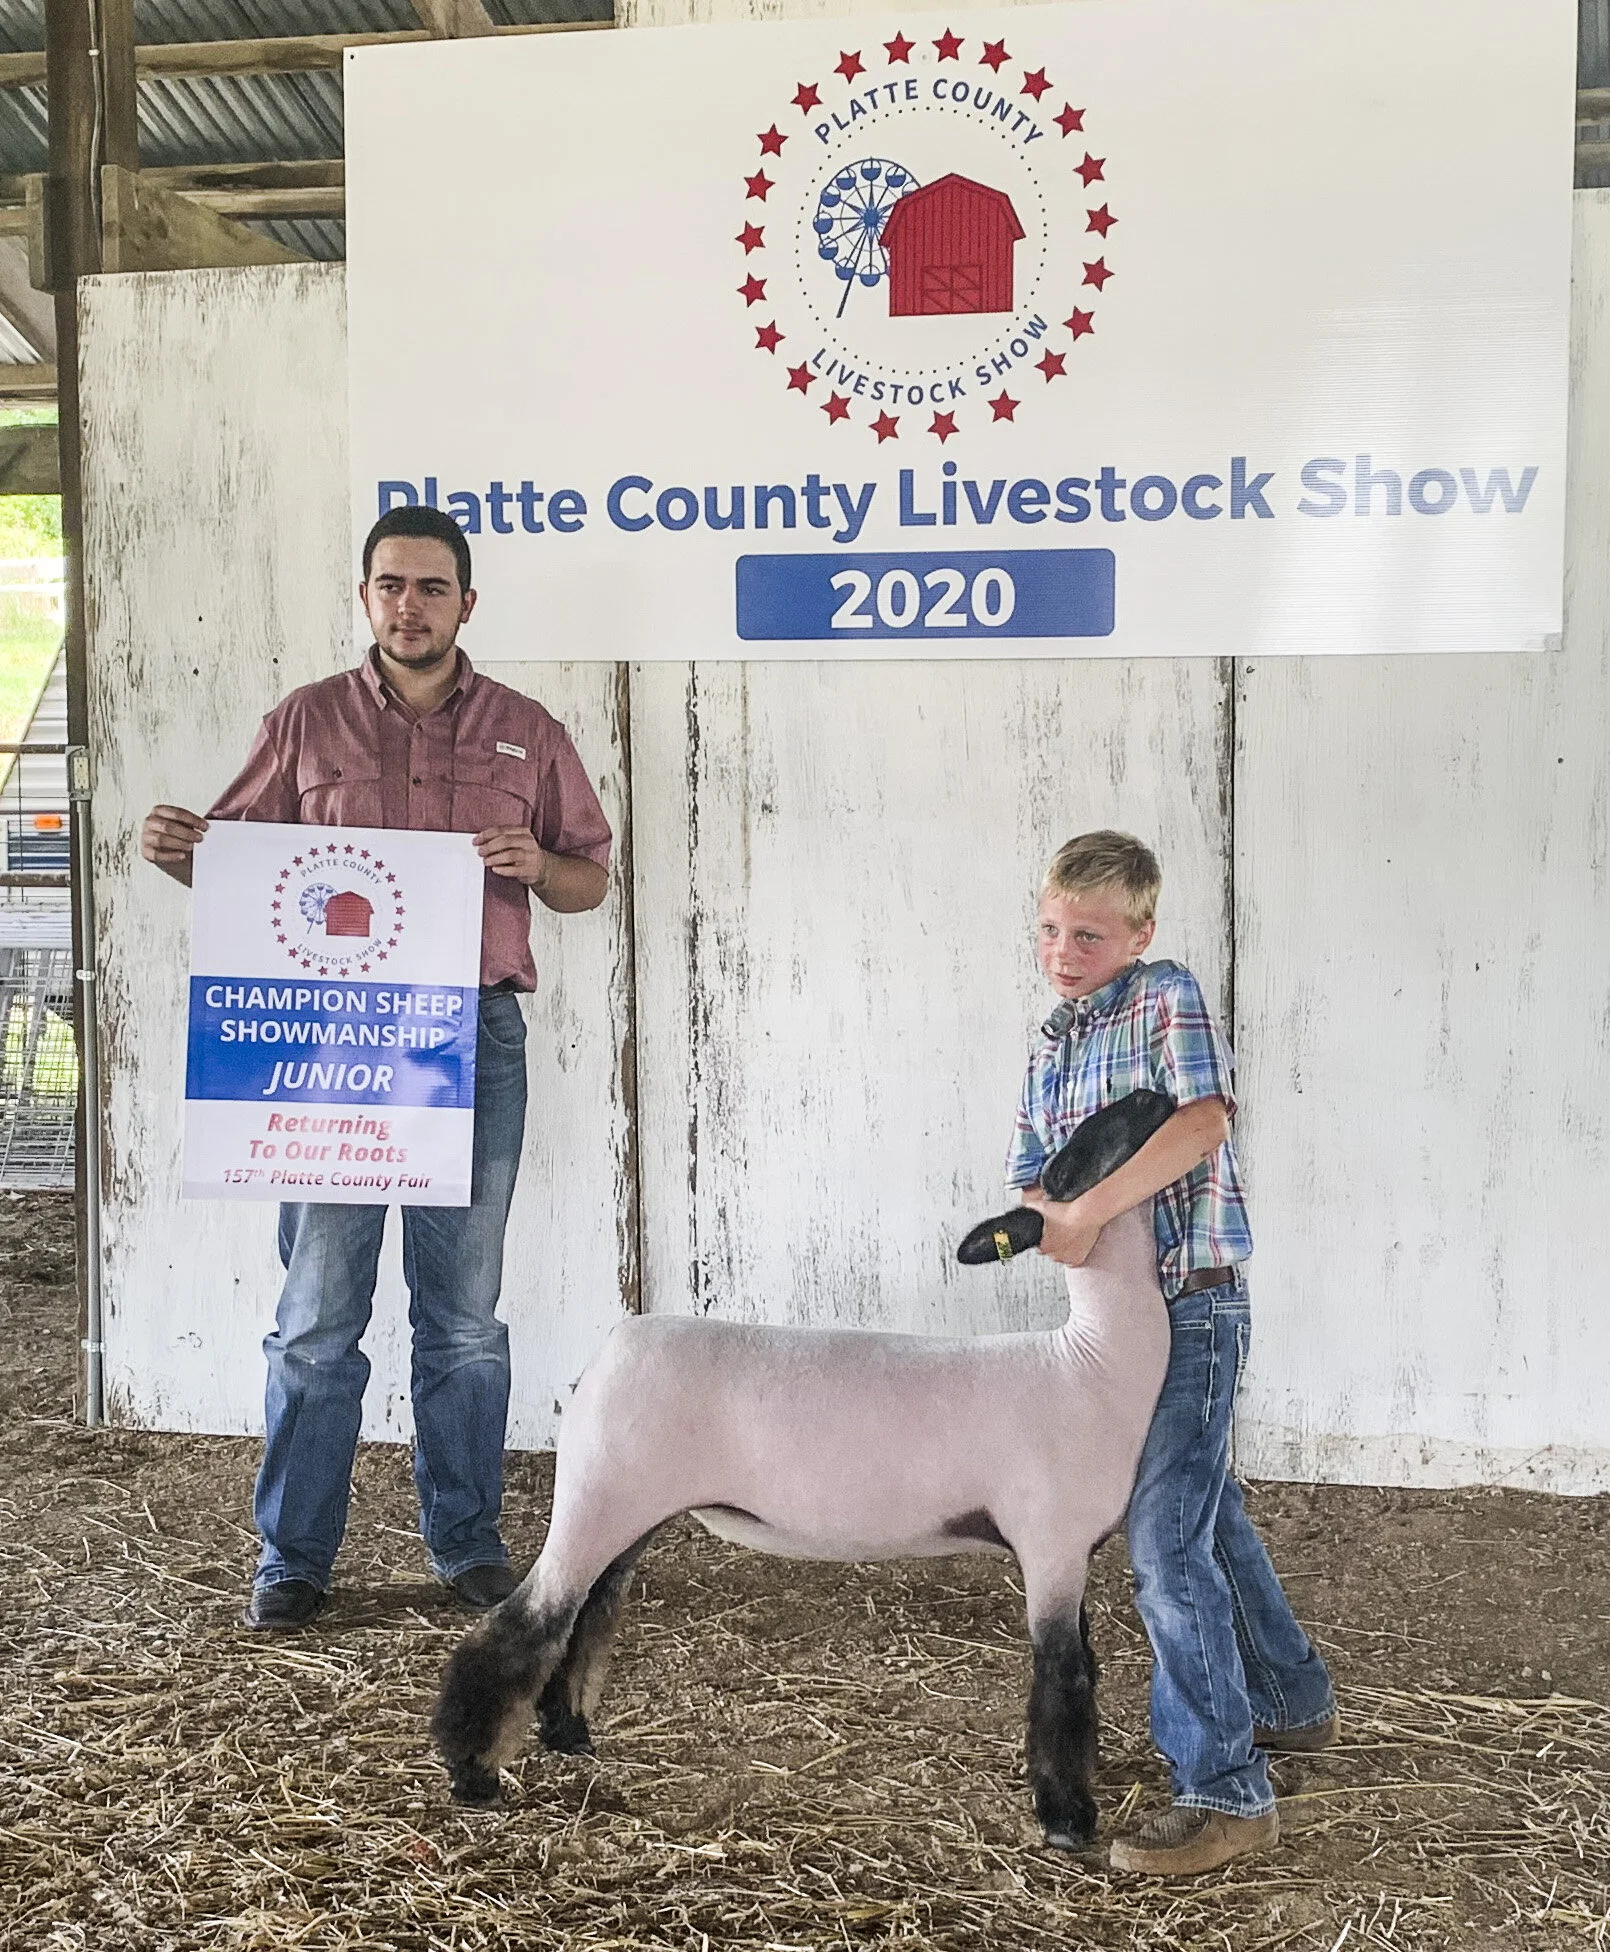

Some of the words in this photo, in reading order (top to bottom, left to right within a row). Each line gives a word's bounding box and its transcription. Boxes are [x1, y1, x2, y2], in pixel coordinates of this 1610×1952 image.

[813, 79, 920, 145] PLATTE
[932, 78, 1045, 146] COUNTY
[811, 347, 967, 406] LIVESTOCK
[975, 313, 1049, 386] SHOW
[606, 474, 877, 544] County
[899, 456, 1276, 527] Livestock
[1297, 454, 1539, 518] Show
[830, 567, 1016, 629] 2020
[301, 858, 339, 877] PLATTE
[342, 859, 382, 885] COUNTY
[297, 943, 353, 965] LIVESTOCK
[356, 938, 382, 960] SHOW
[205, 985, 366, 1013] CHAMPION
[376, 991, 463, 1017] SHEEP
[220, 1020, 446, 1049] SHOWMANSHIP
[262, 1061, 394, 1095] JUNIOR
[267, 1112, 392, 1141] Returning
[249, 1139, 277, 1159] To
[285, 1141, 331, 1160] Our
[337, 1142, 408, 1163] Roots
[223, 1168, 265, 1183] 157th
[270, 1169, 324, 1186] Platte
[330, 1171, 392, 1191] County
[397, 1173, 432, 1189] Fair
